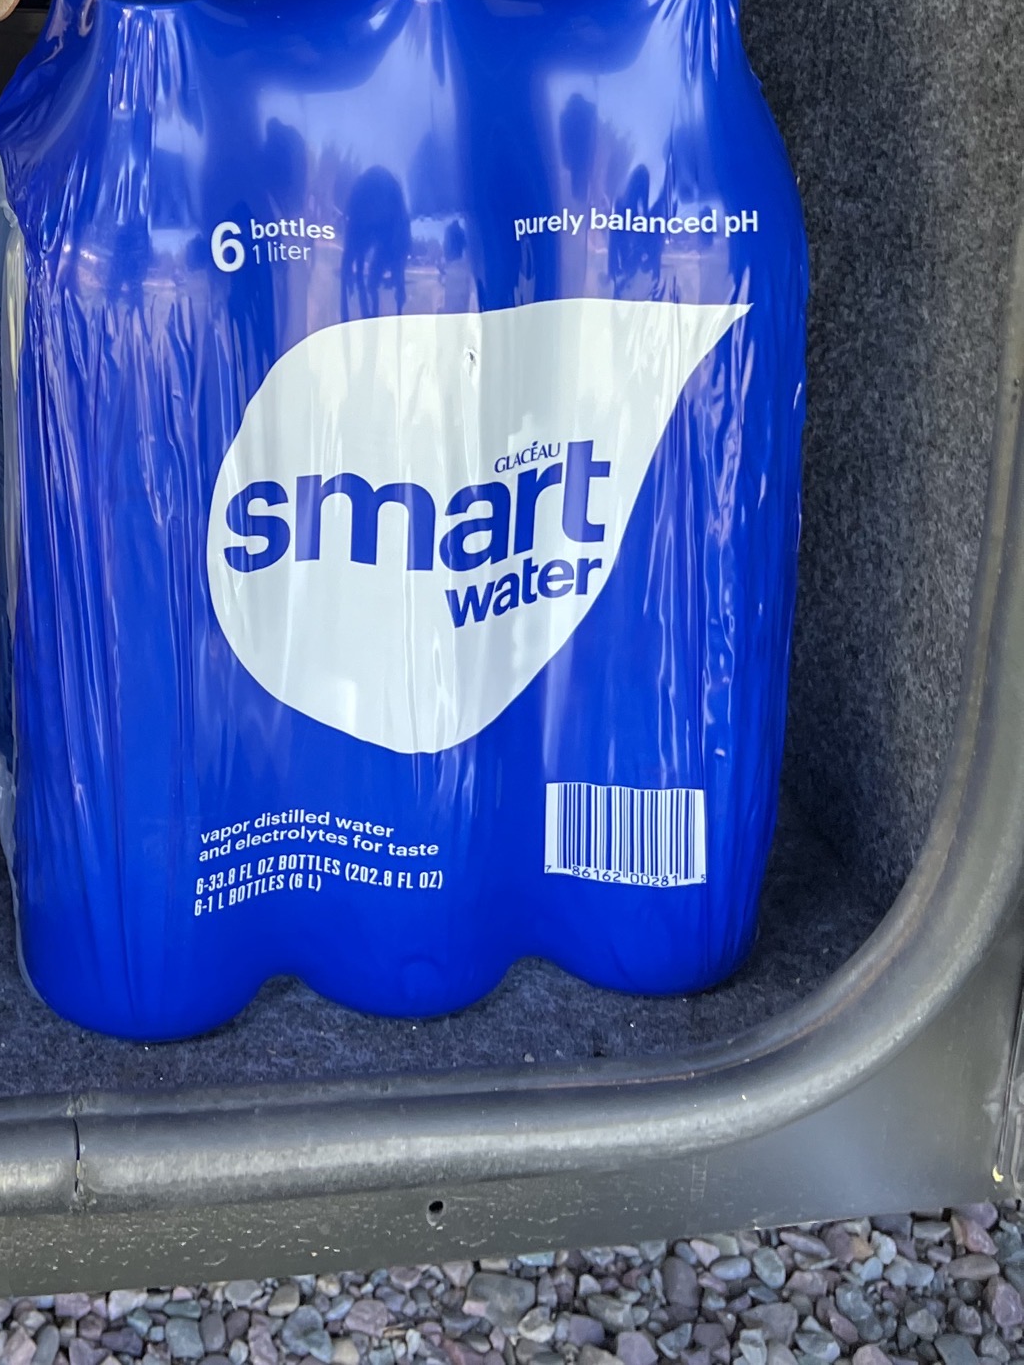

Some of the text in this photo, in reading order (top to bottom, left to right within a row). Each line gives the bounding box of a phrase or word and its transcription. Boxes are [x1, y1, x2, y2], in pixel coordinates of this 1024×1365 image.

[250, 218, 335, 240] bottles
[514, 207, 758, 240] purely balanced pH
[210, 221, 245, 272] 6
[252, 241, 311, 264] 1 liter
[494, 441, 561, 473] GLACÉAU
[224, 440, 611, 573] smart
[445, 557, 602, 629] water
[199, 826, 439, 862] and electrolytes for taste
[201, 809, 394, 844] vapor distilled water
[196, 854, 443, 895] 6-33.8 FL OZ BOTTLES (202.8 FL OZ)
[572, 865, 621, 883] 86162
[630, 873, 679, 887] 00281
[194, 872, 322, 917] 6-1 L BOTTLES (6 L)
